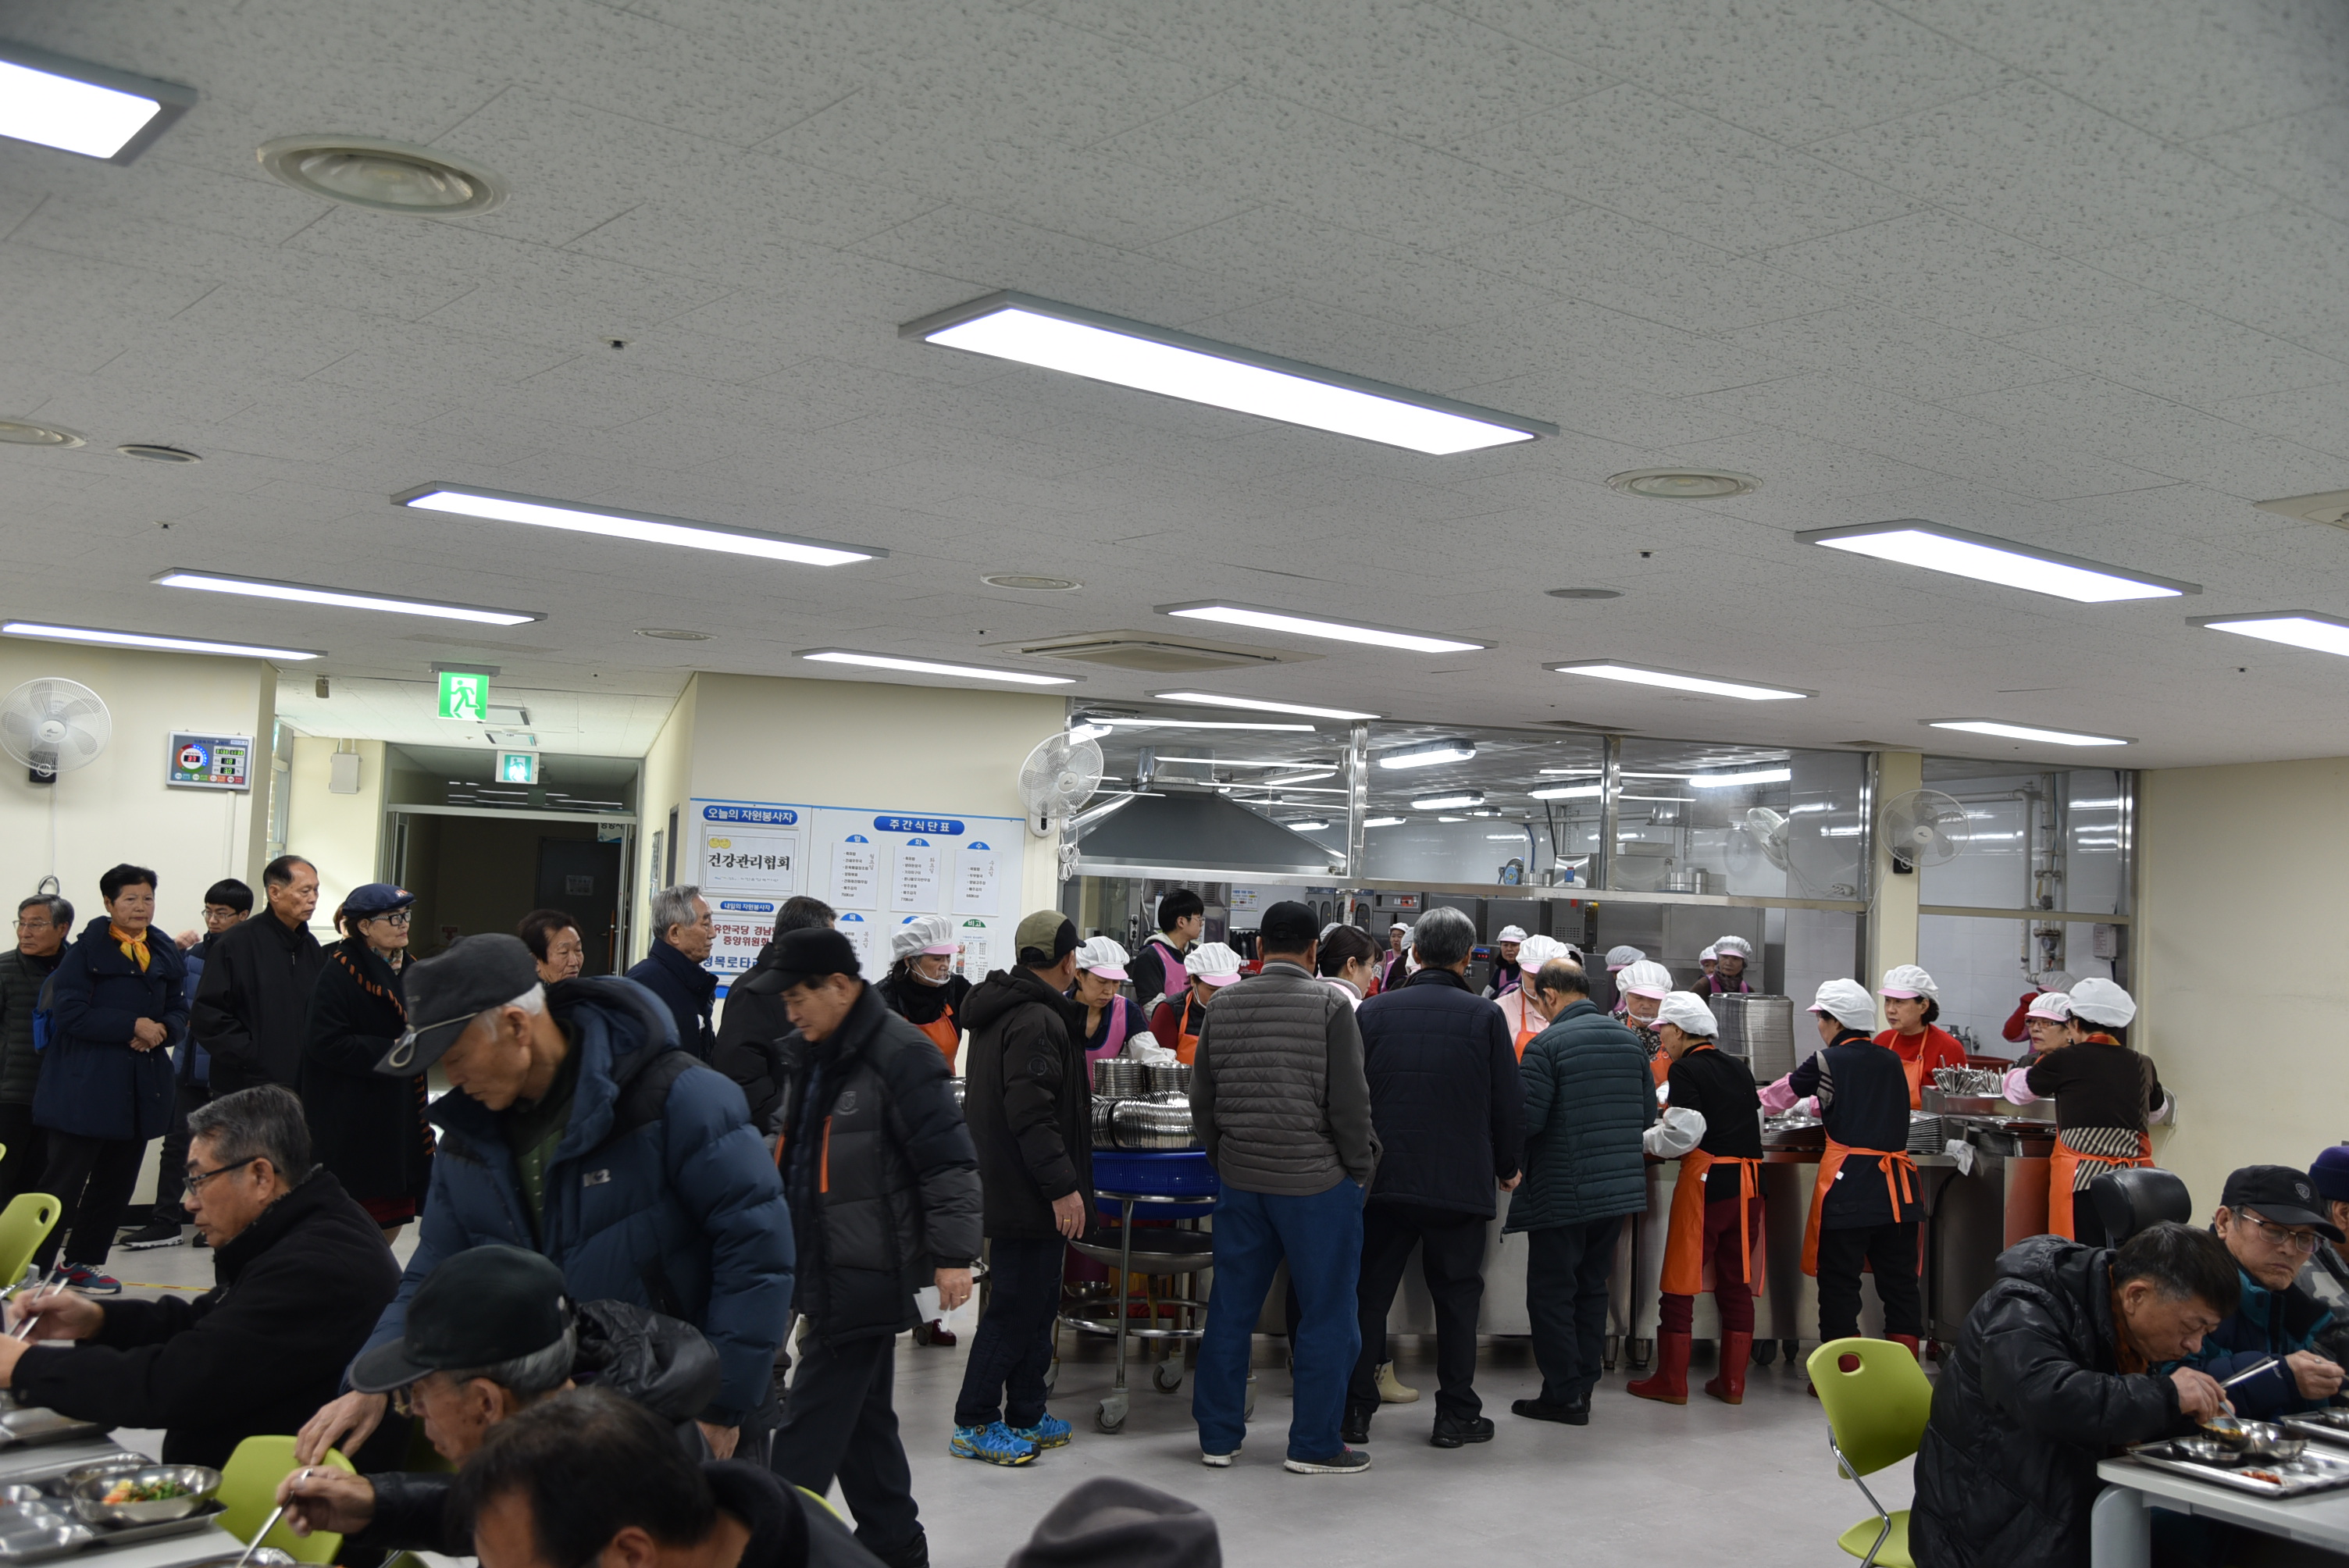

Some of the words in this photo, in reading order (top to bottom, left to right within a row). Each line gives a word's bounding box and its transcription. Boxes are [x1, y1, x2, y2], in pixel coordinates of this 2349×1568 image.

[708, 808, 739, 820] 오늘의
[742, 810, 793, 823] 자원봉사자
[889, 819, 950, 832] 주간식단표
[708, 853, 790, 871] 건강관리협회
[714, 924, 750, 935] 유한국당
[583, 1168, 611, 1187] K2
